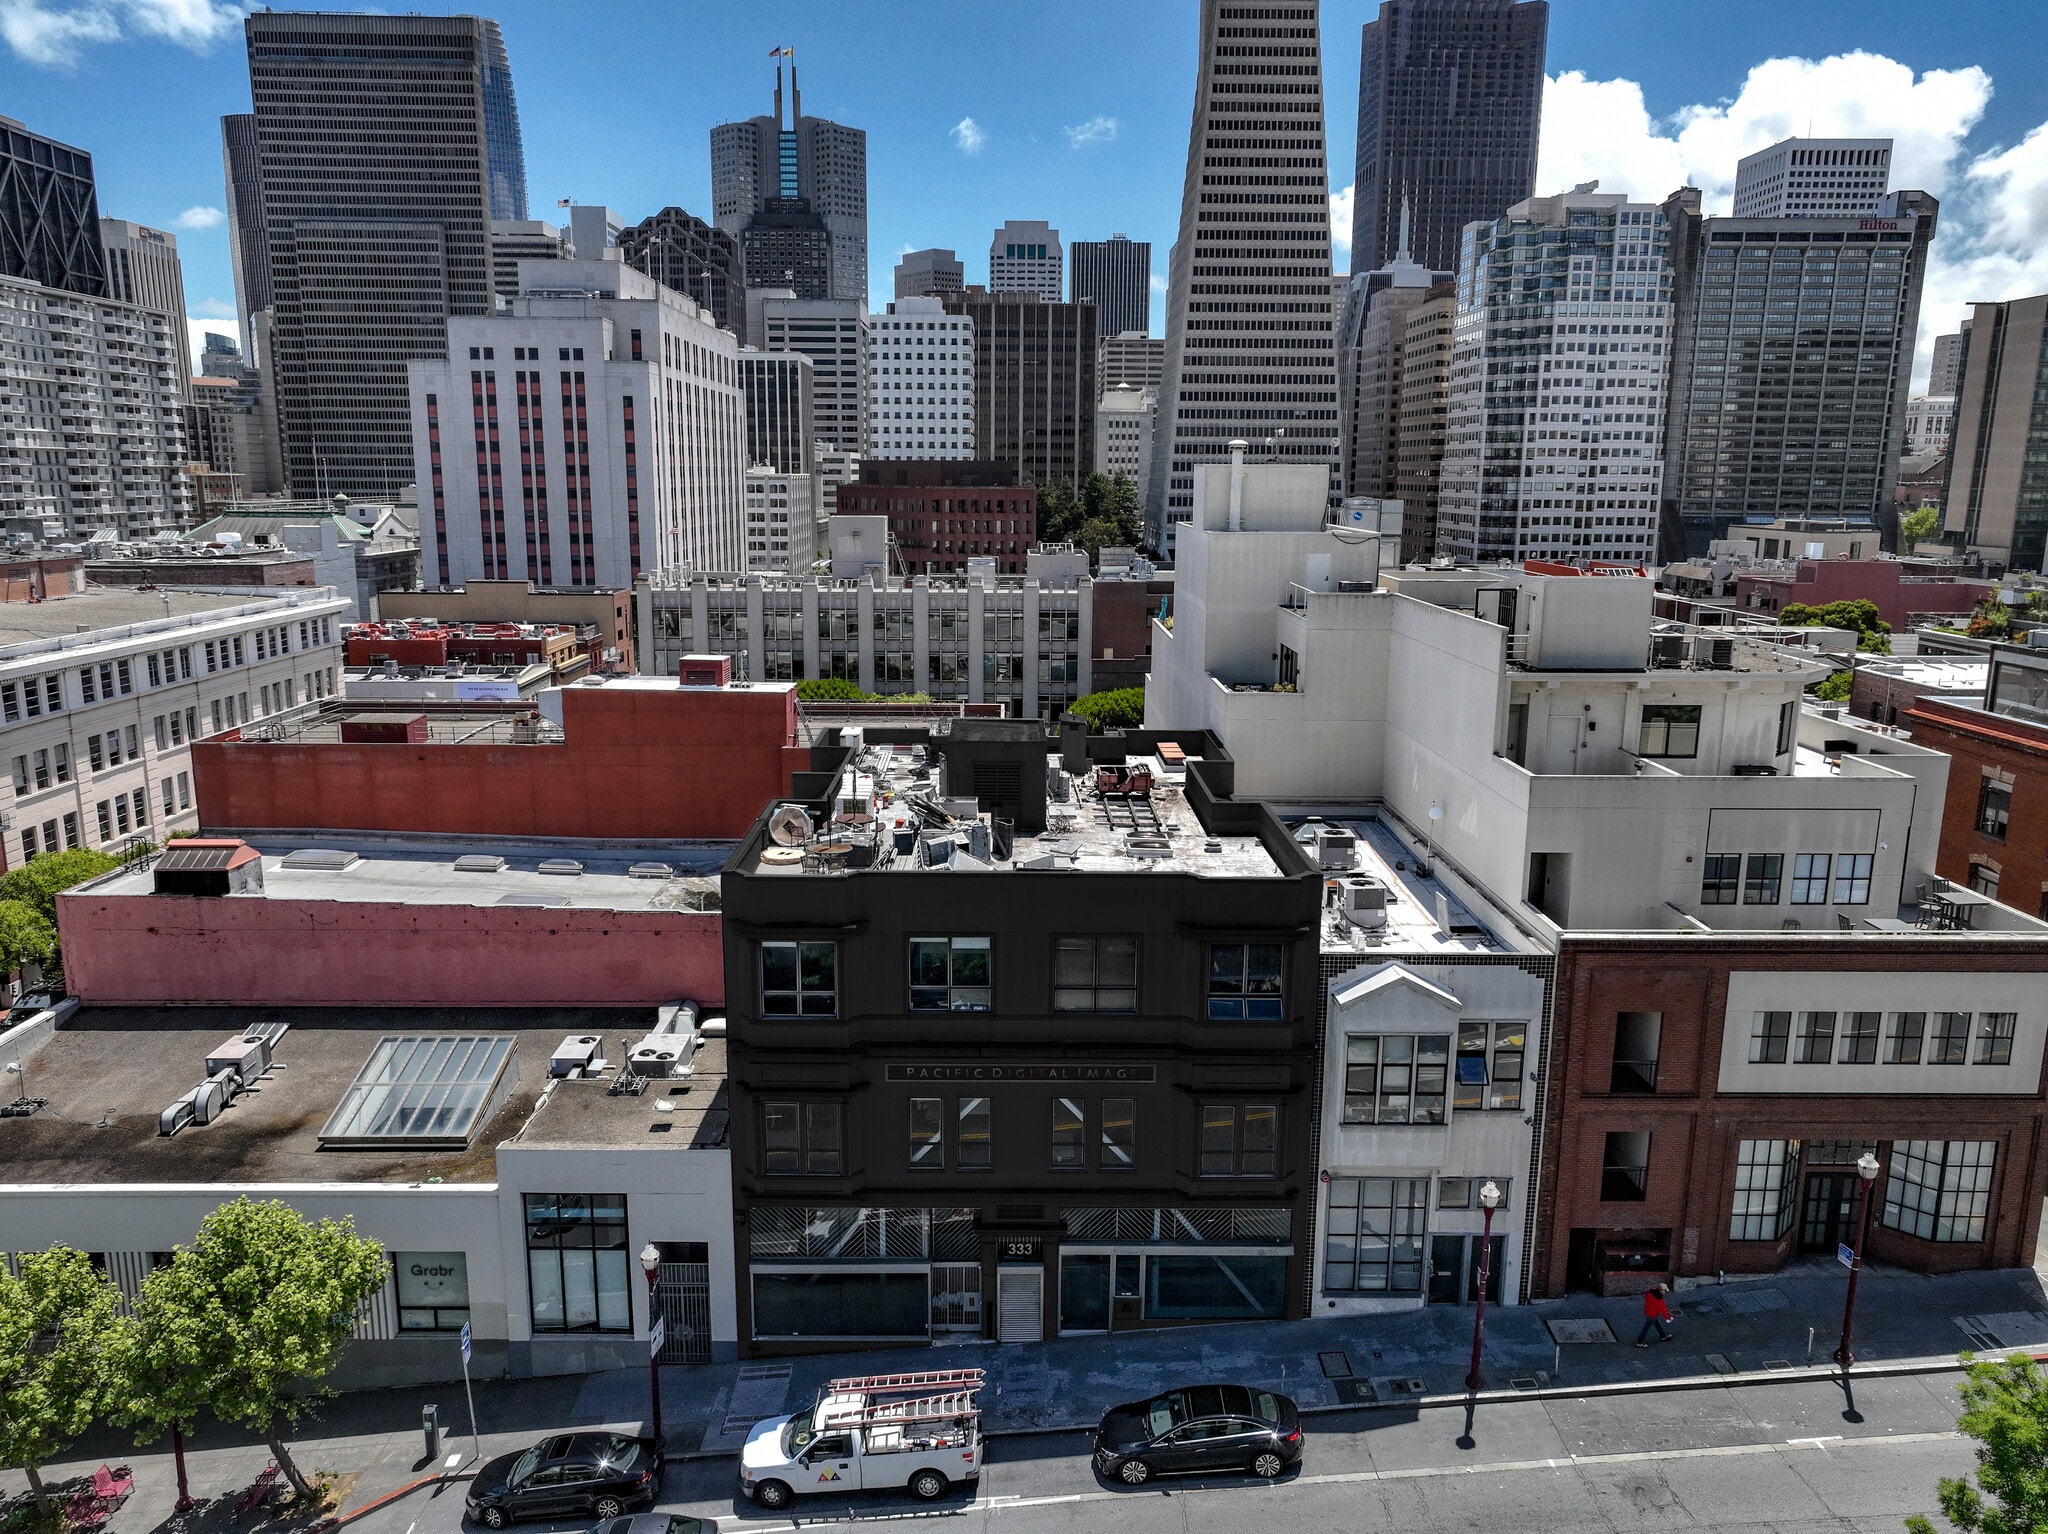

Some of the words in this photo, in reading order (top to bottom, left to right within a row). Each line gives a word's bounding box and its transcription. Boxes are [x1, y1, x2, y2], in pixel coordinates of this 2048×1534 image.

[1860, 220, 1898, 230] Hilton
[906, 1067, 983, 1078] PACIFIC
[992, 1067, 1069, 1078] DIGITAL
[1008, 1243, 1033, 1255] 333
[410, 1264, 454, 1276] Grabr
